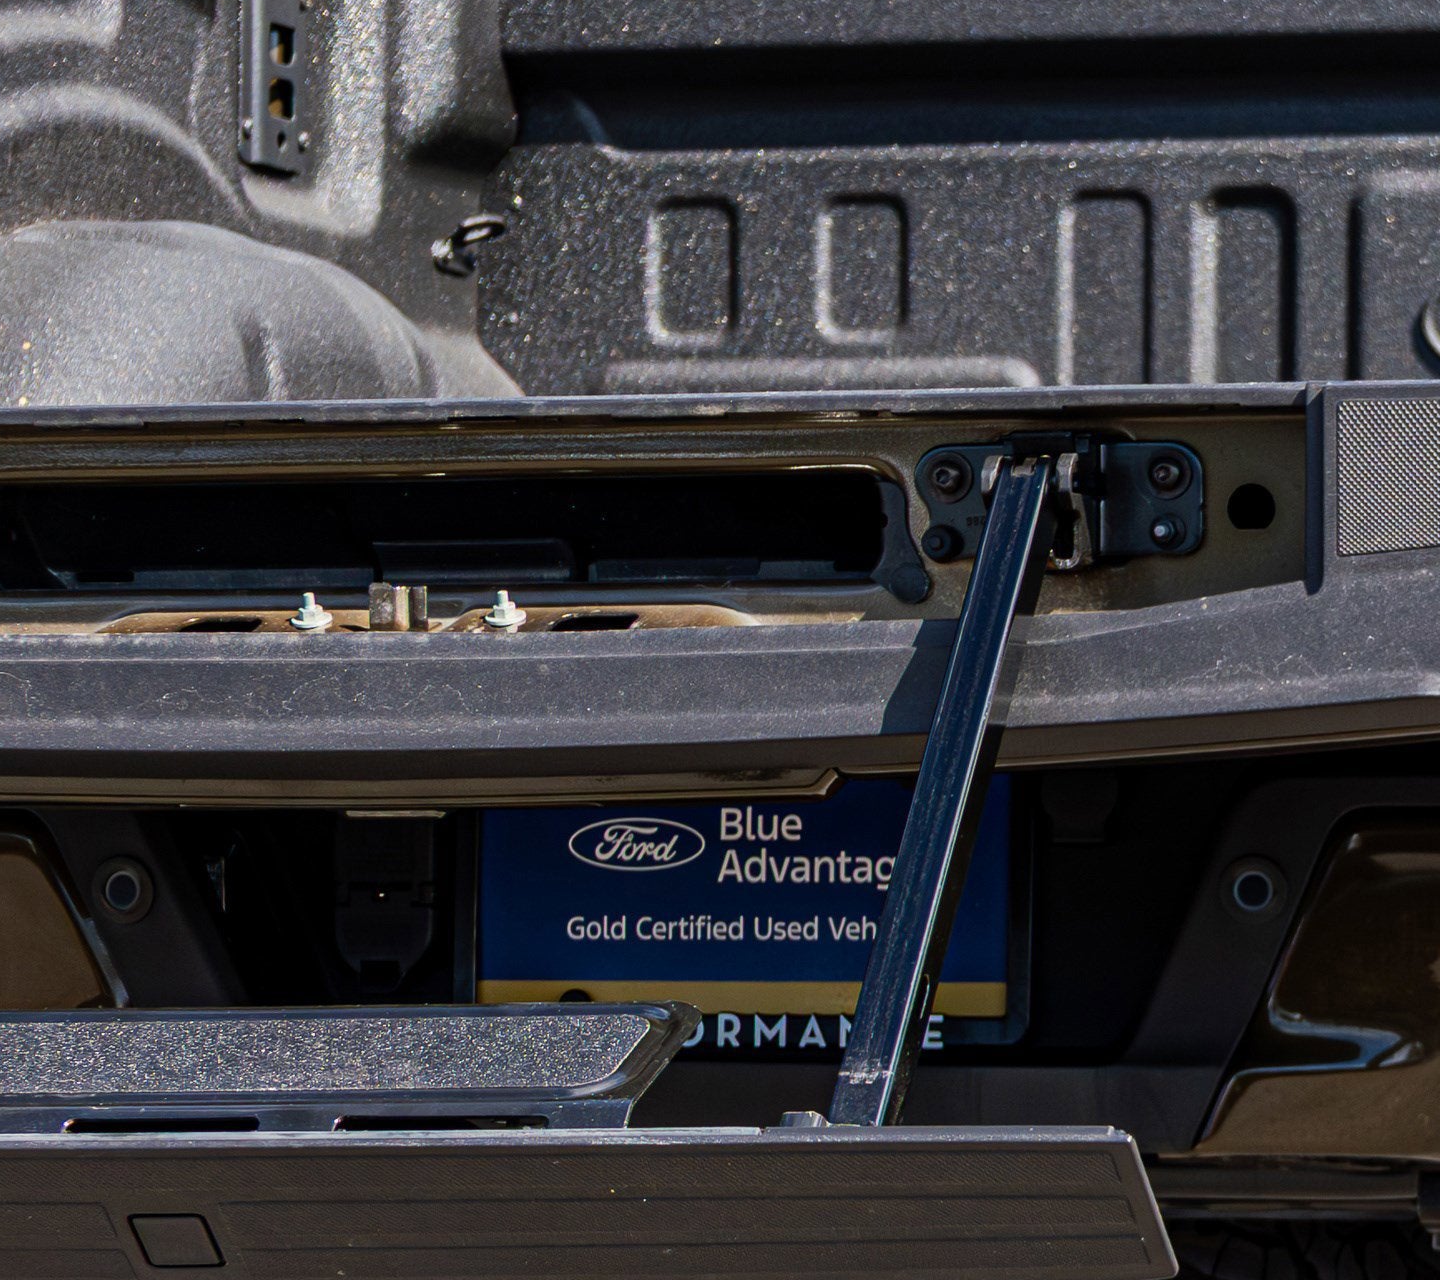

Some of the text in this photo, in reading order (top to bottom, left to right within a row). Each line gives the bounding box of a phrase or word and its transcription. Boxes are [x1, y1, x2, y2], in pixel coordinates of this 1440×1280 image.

[719, 805, 803, 842] Blue
[594, 824, 680, 862] Ford
[717, 847, 897, 891] Advantag
[566, 914, 877, 941] Gold Certified Used Veh
